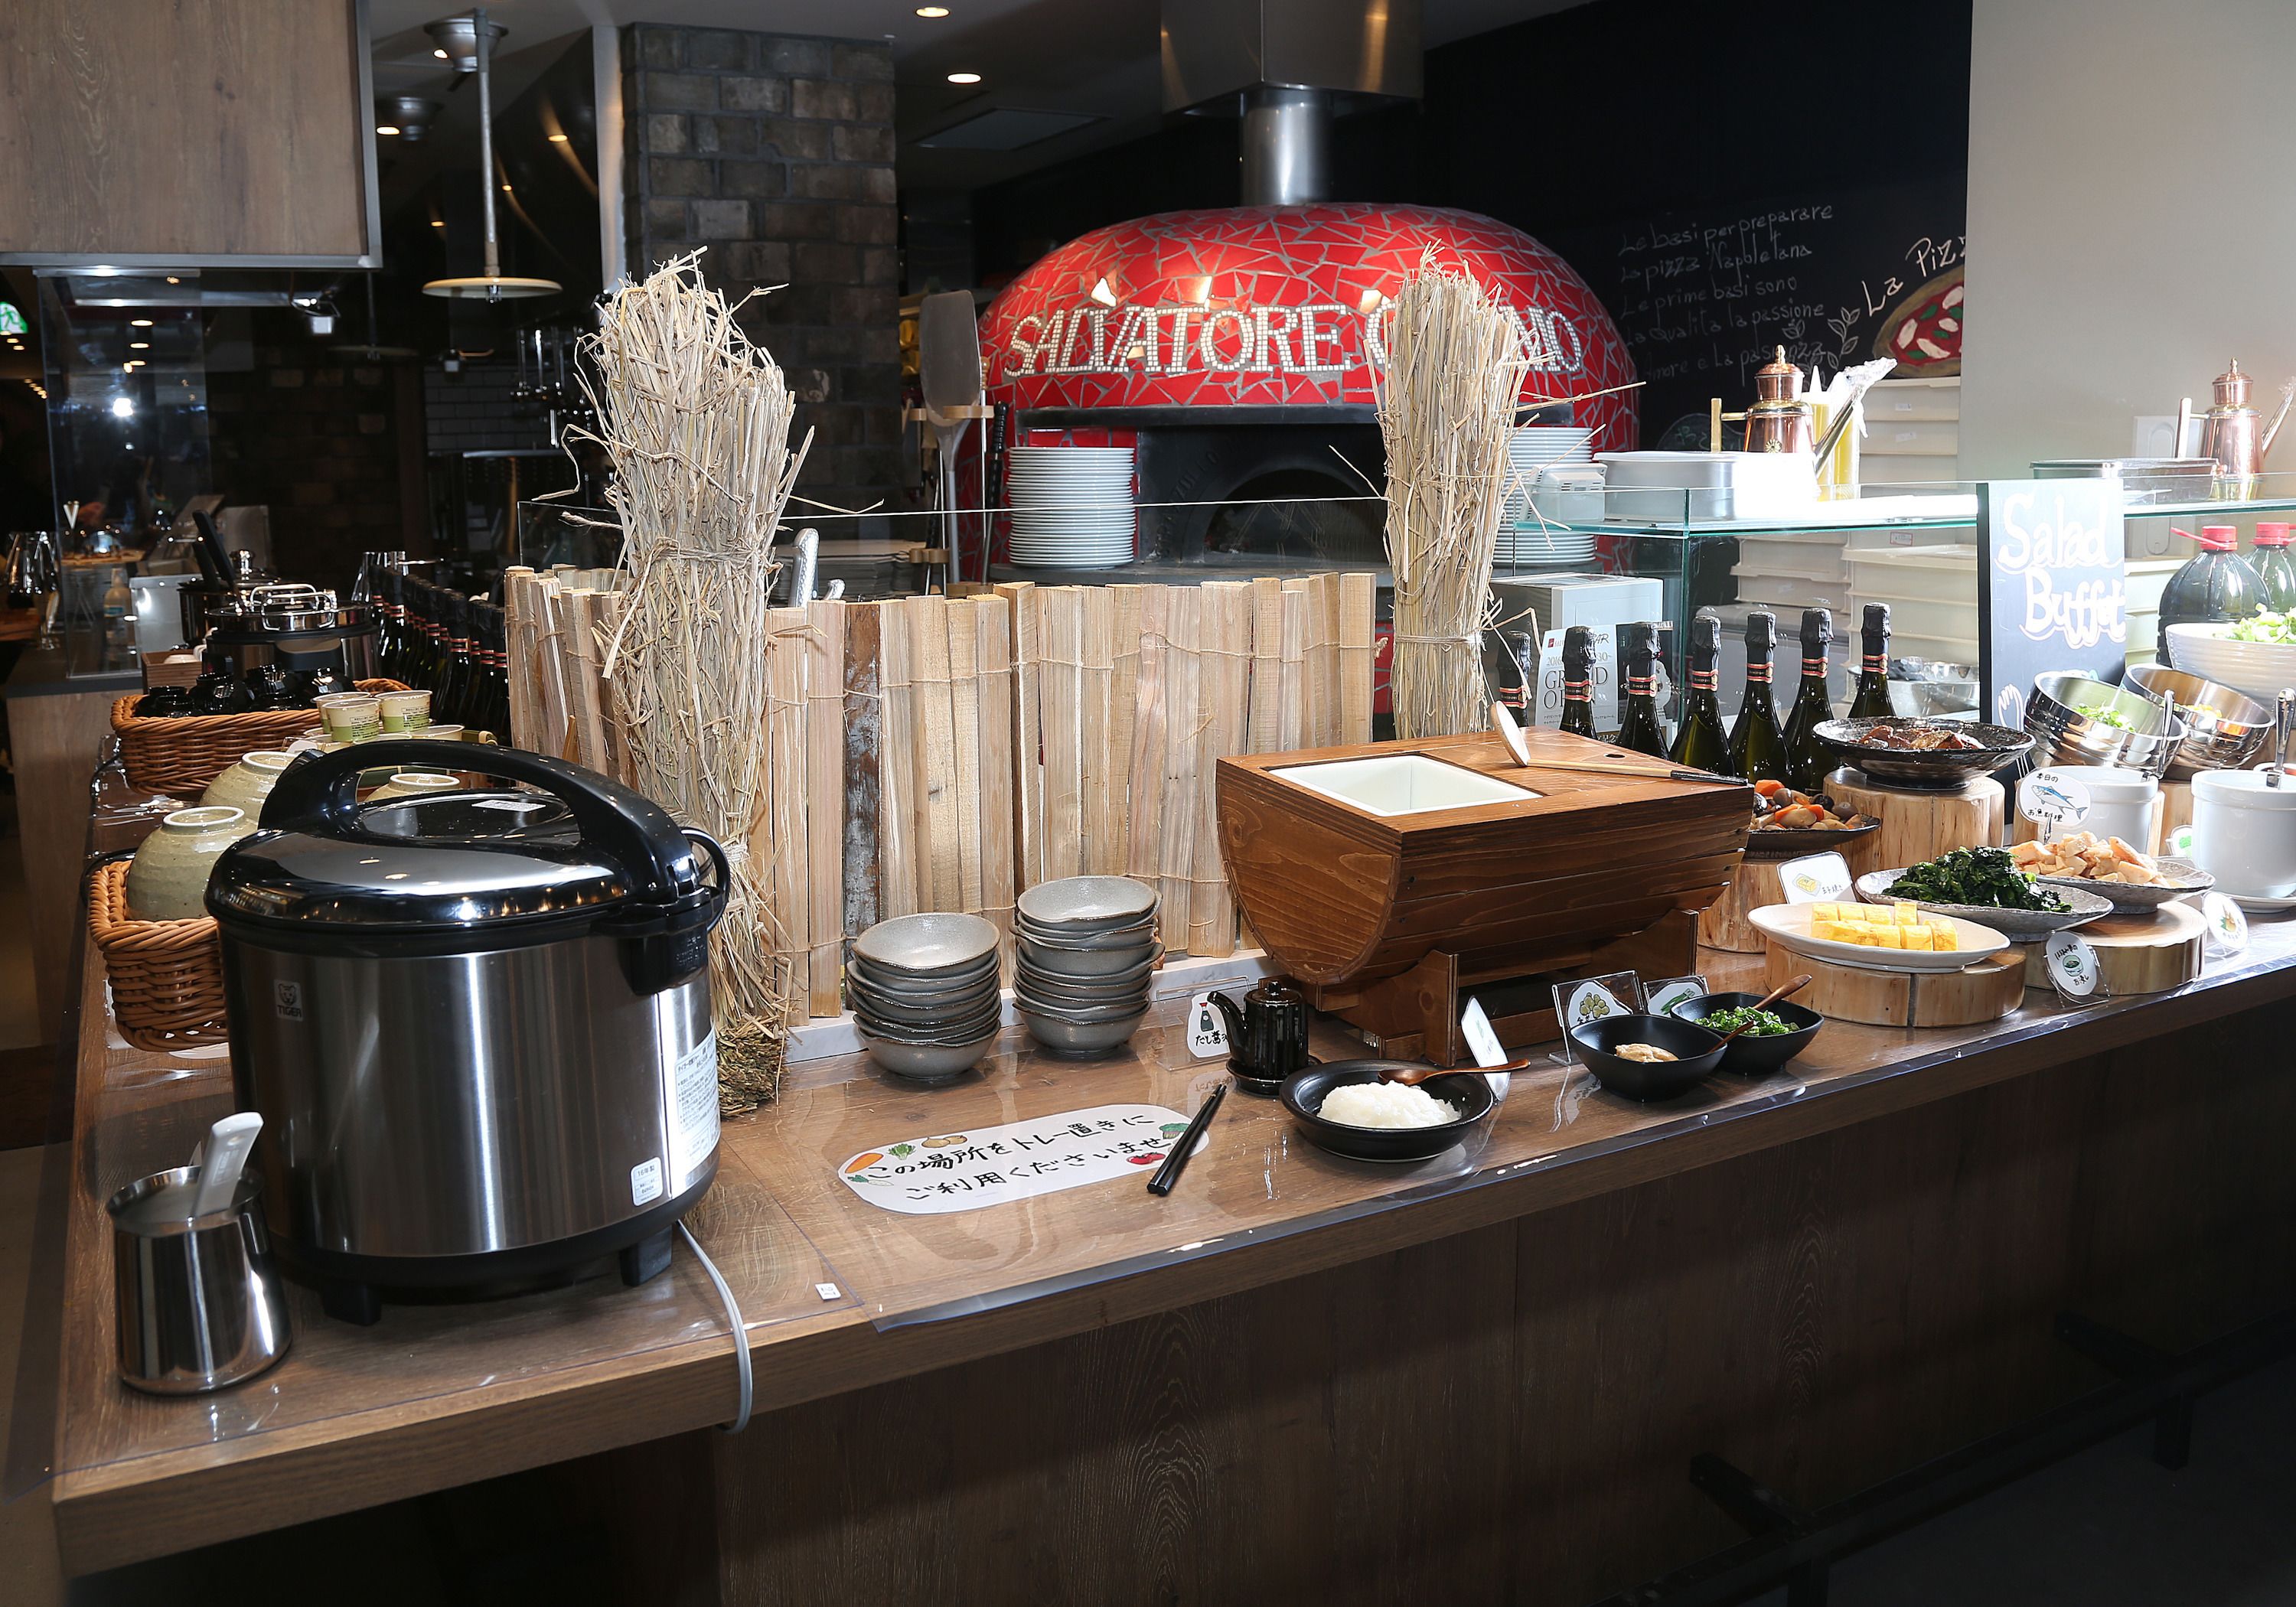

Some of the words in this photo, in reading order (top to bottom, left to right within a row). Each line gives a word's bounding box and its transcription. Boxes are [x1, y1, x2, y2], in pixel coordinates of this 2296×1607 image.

[1650, 223, 1698, 249] basi
[1704, 224, 1736, 254] per
[1645, 256, 1700, 292] pizza
[1862, 277, 1903, 317] La
[1655, 289, 1707, 328] prime
[1711, 274, 1750, 299] basi
[1756, 276, 1798, 296] sono
[1004, 305, 1351, 376] SALVATORE
[1752, 298, 1825, 355] passione
[1996, 492, 2111, 568] Salad
[2022, 567, 2125, 645] Buffet
[2036, 772, 2059, 783] 本日の
[276, 1004, 302, 1019] TIGER
